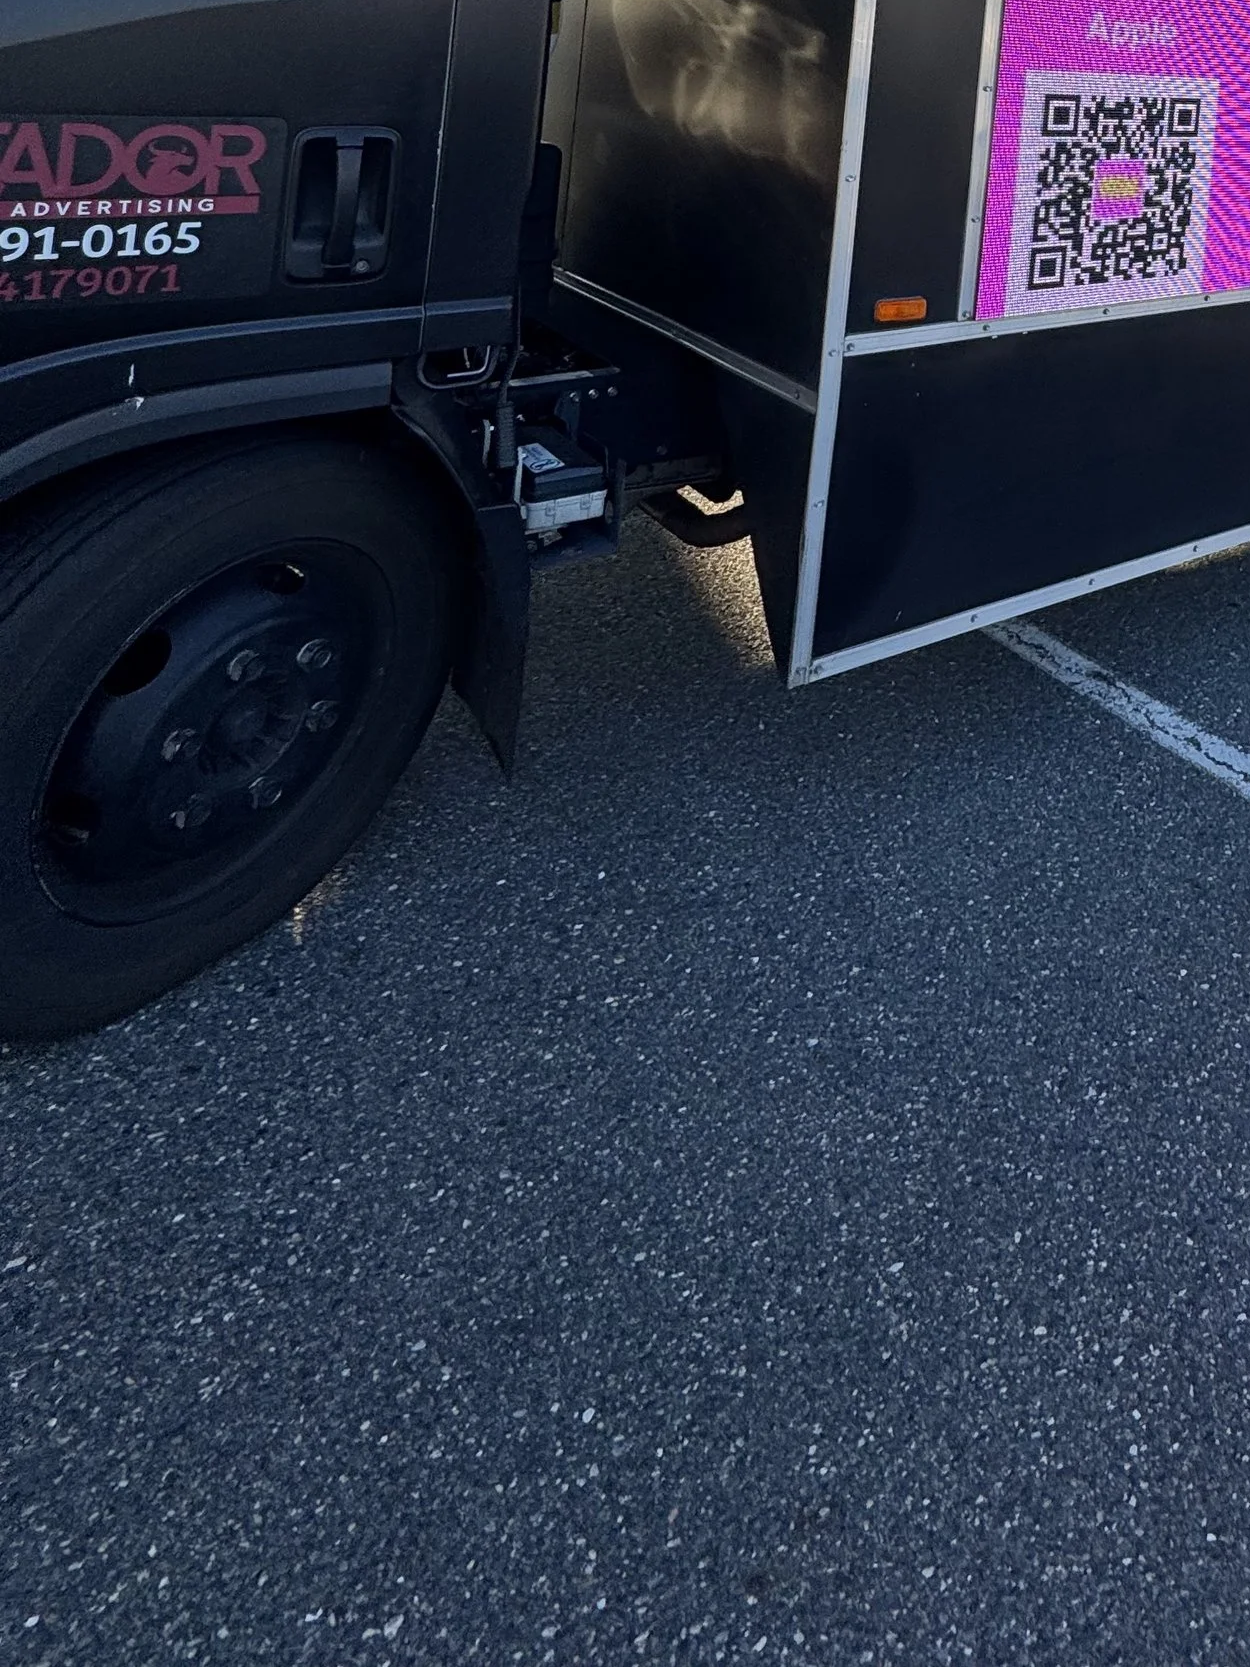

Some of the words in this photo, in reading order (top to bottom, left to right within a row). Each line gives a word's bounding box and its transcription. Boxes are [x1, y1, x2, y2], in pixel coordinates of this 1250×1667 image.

[1088, 12, 1178, 51] Apple
[0, 122, 267, 198] ADOR
[10, 198, 215, 217] ADVERTISING
